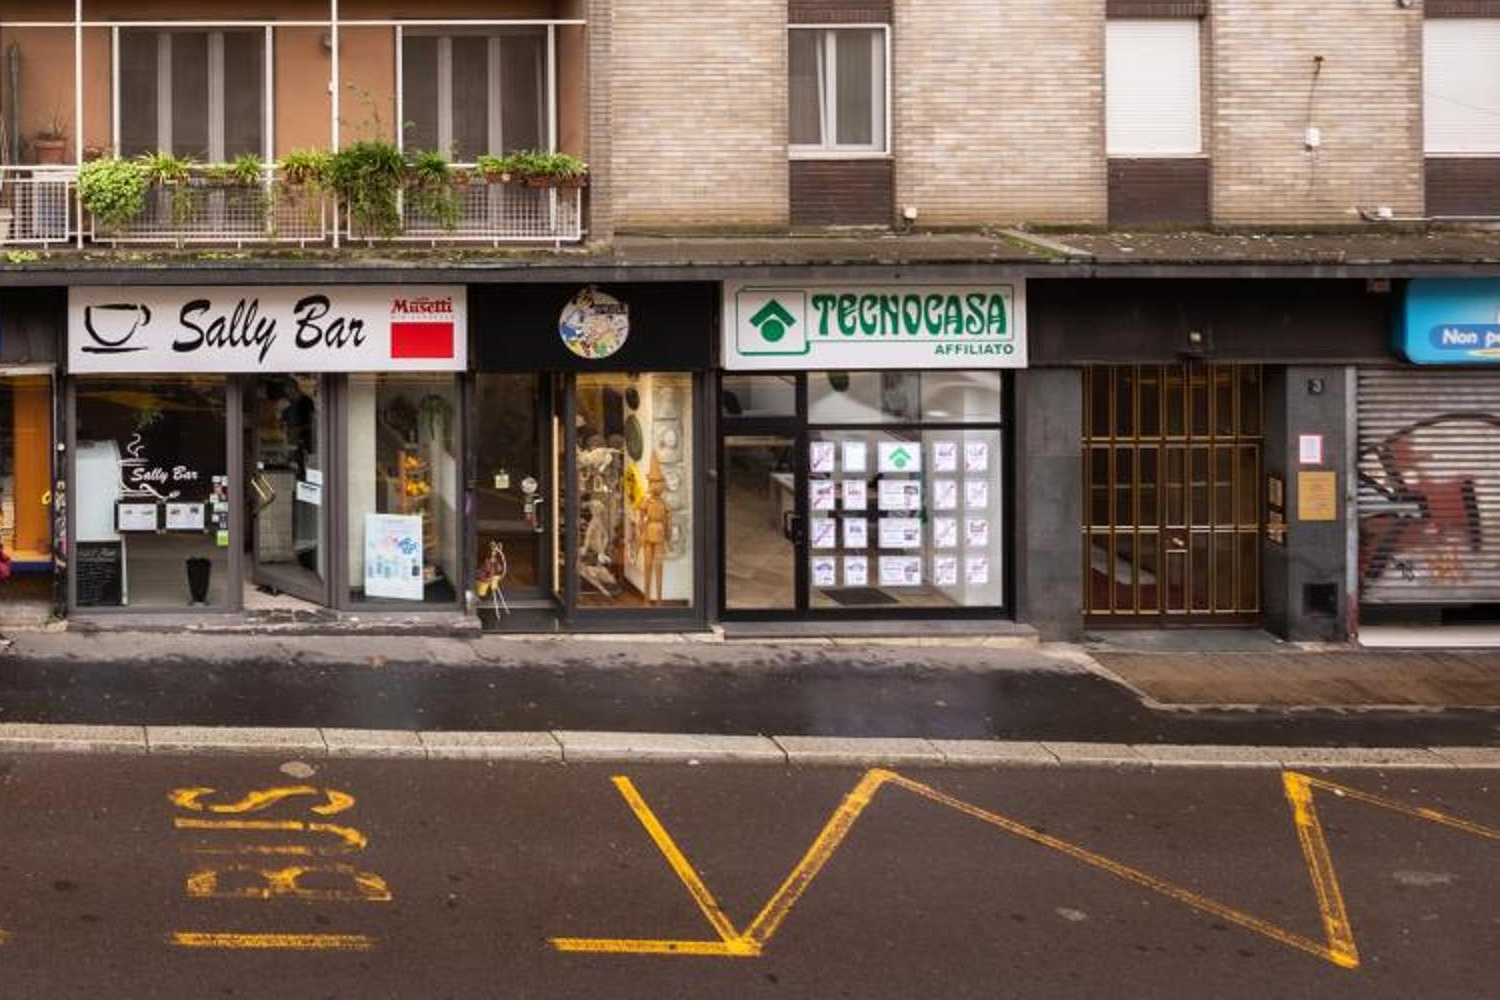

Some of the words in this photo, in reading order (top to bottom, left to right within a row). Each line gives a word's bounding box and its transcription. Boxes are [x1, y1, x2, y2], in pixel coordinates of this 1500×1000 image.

[811, 293, 1007, 337] TECNOCASA
[172, 299, 277, 363] Sally
[293, 294, 365, 350] Bar
[1442, 328, 1478, 345] Non
[934, 343, 1015, 356] AFFILIATO
[130, 467, 168, 484] Sally
[172, 465, 198, 481] Bar
